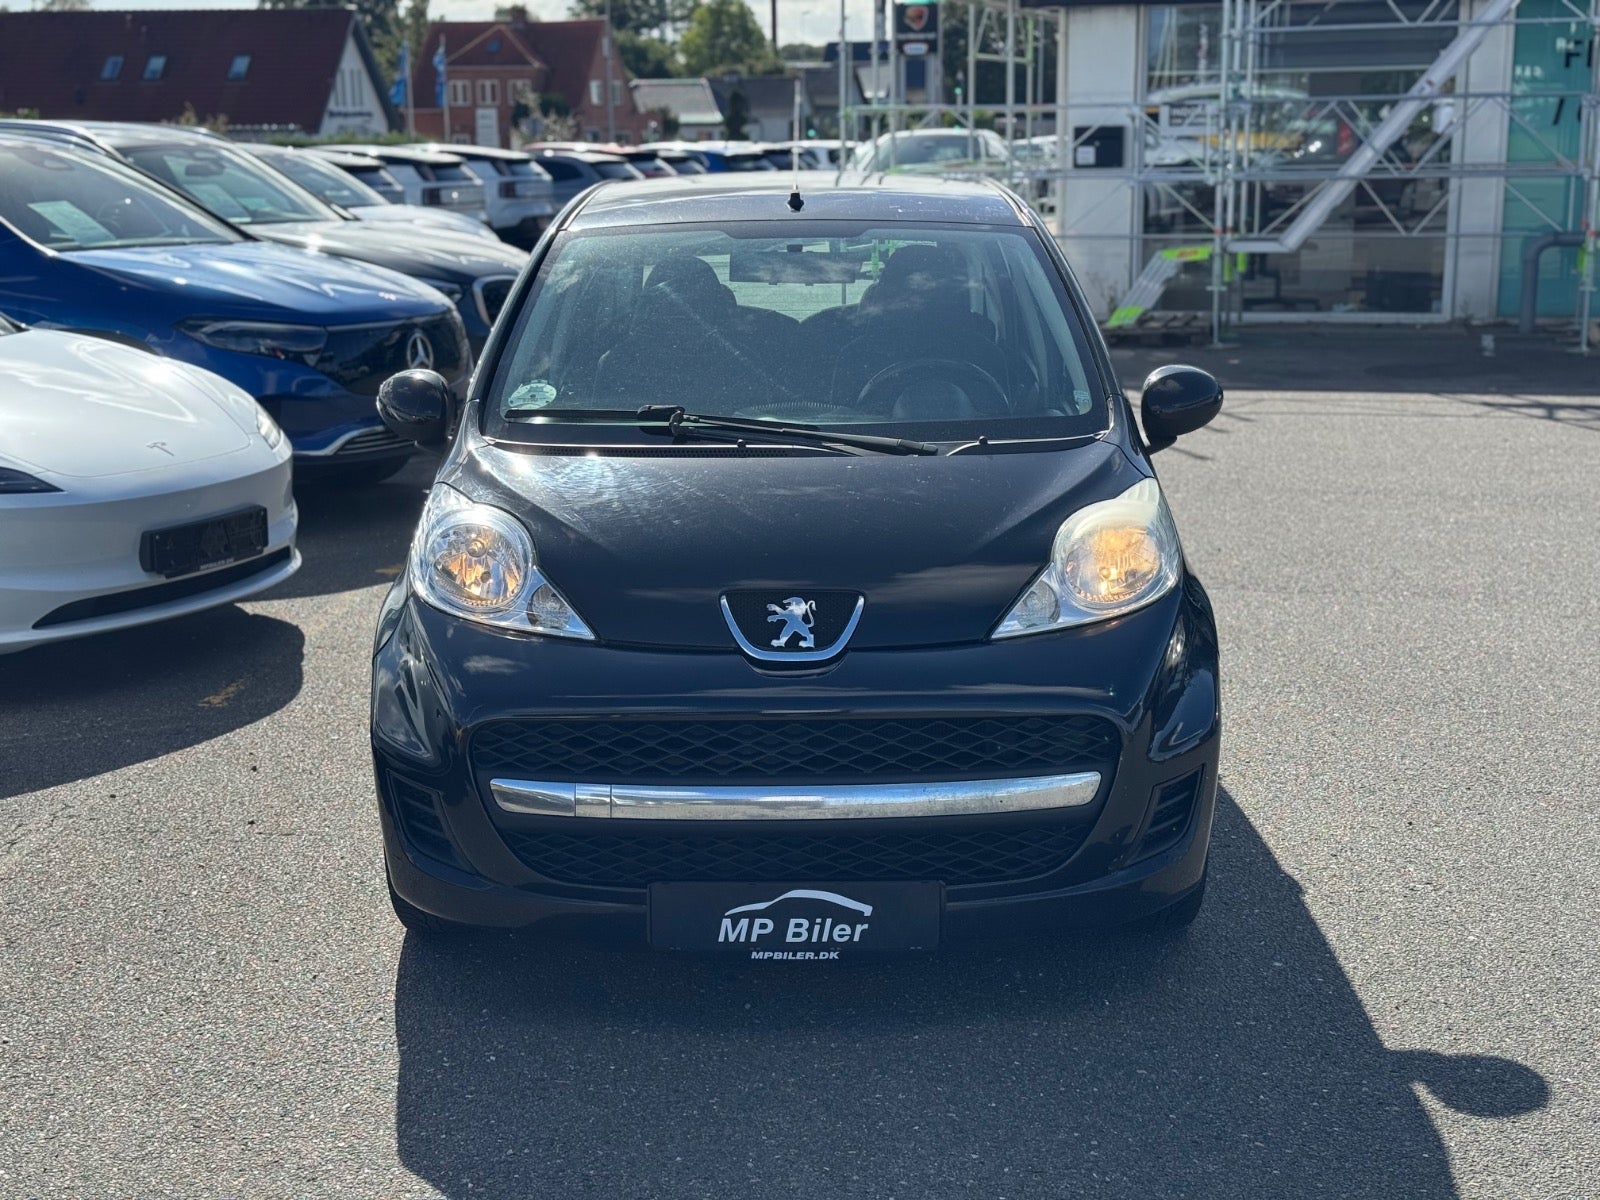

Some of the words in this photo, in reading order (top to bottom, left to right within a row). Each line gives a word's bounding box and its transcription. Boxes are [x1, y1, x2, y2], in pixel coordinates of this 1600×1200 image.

[718, 918, 774, 943] MP
[785, 918, 869, 943] Biler
[750, 951, 840, 960] MPBILER.DK
